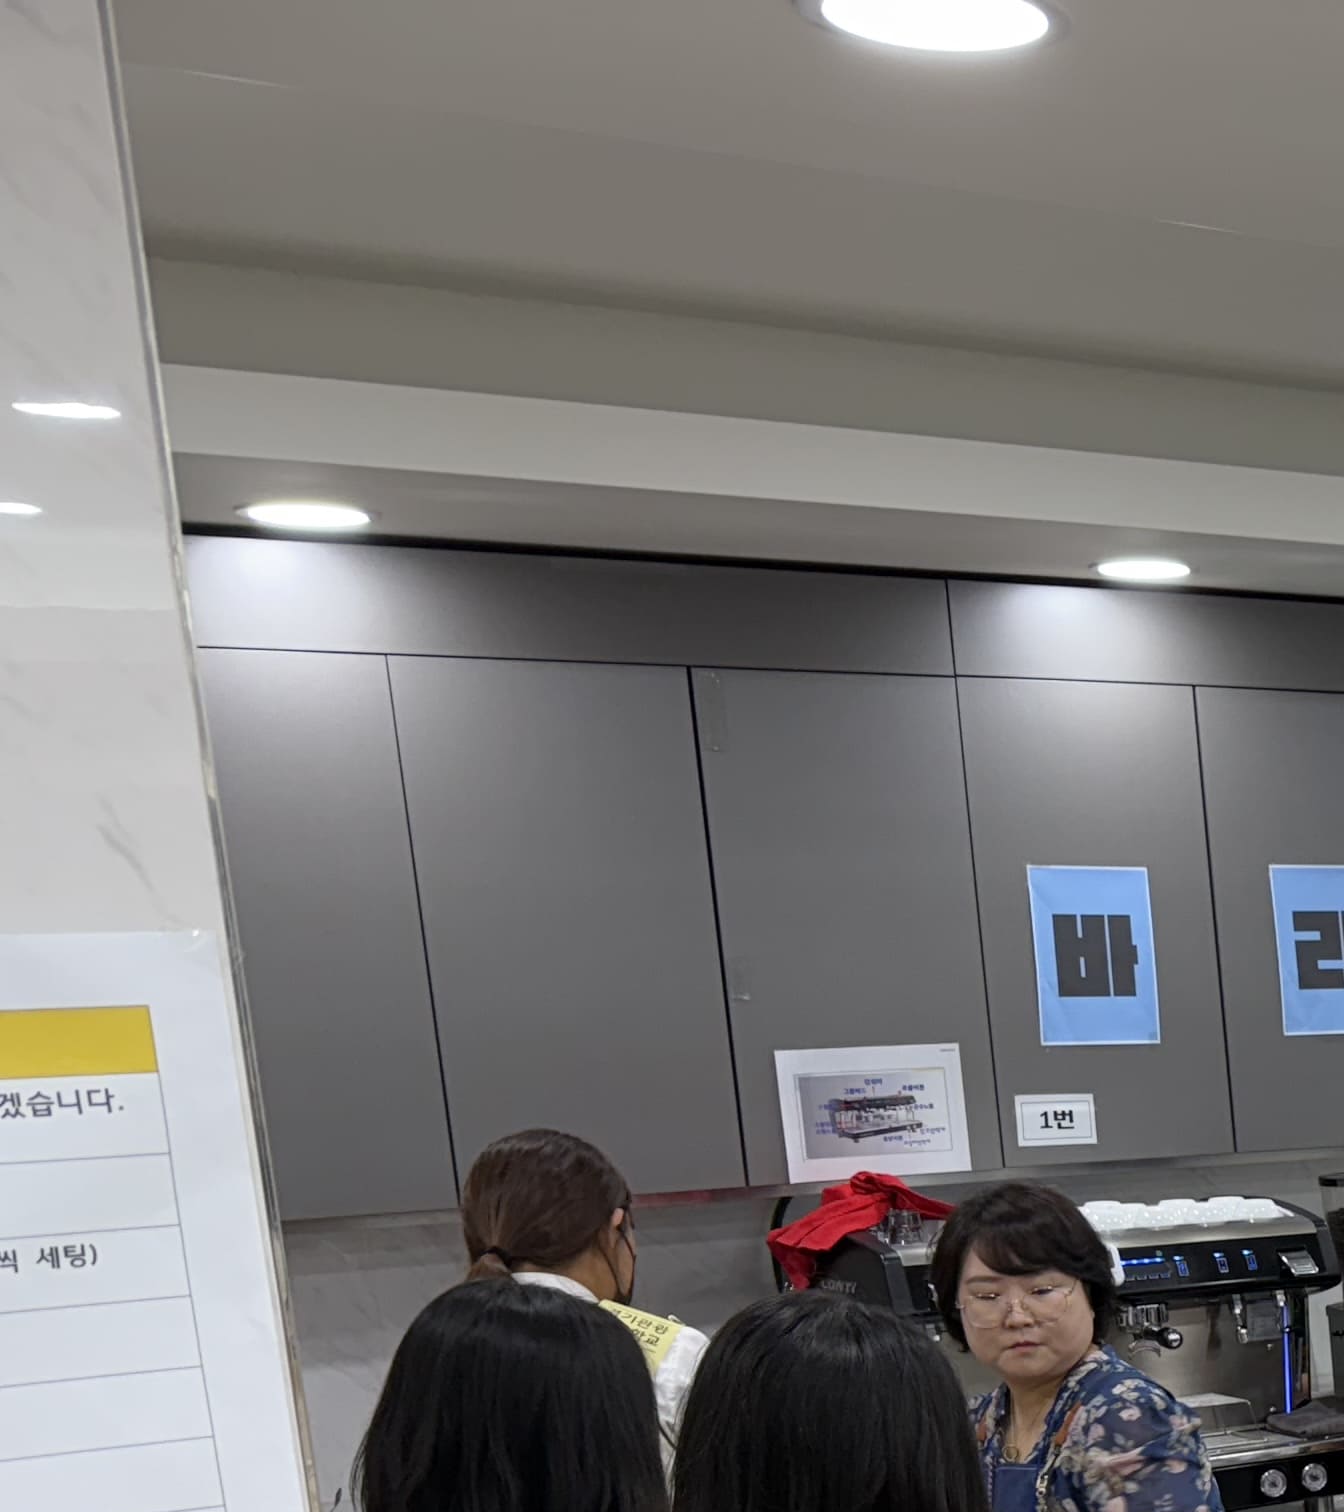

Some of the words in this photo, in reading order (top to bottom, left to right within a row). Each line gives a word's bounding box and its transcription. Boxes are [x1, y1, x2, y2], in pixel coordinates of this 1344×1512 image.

[1052, 913, 1139, 997] 바
[1039, 1109, 1076, 1131] 1번
[36, 1243, 98, 1270] 세팅)
